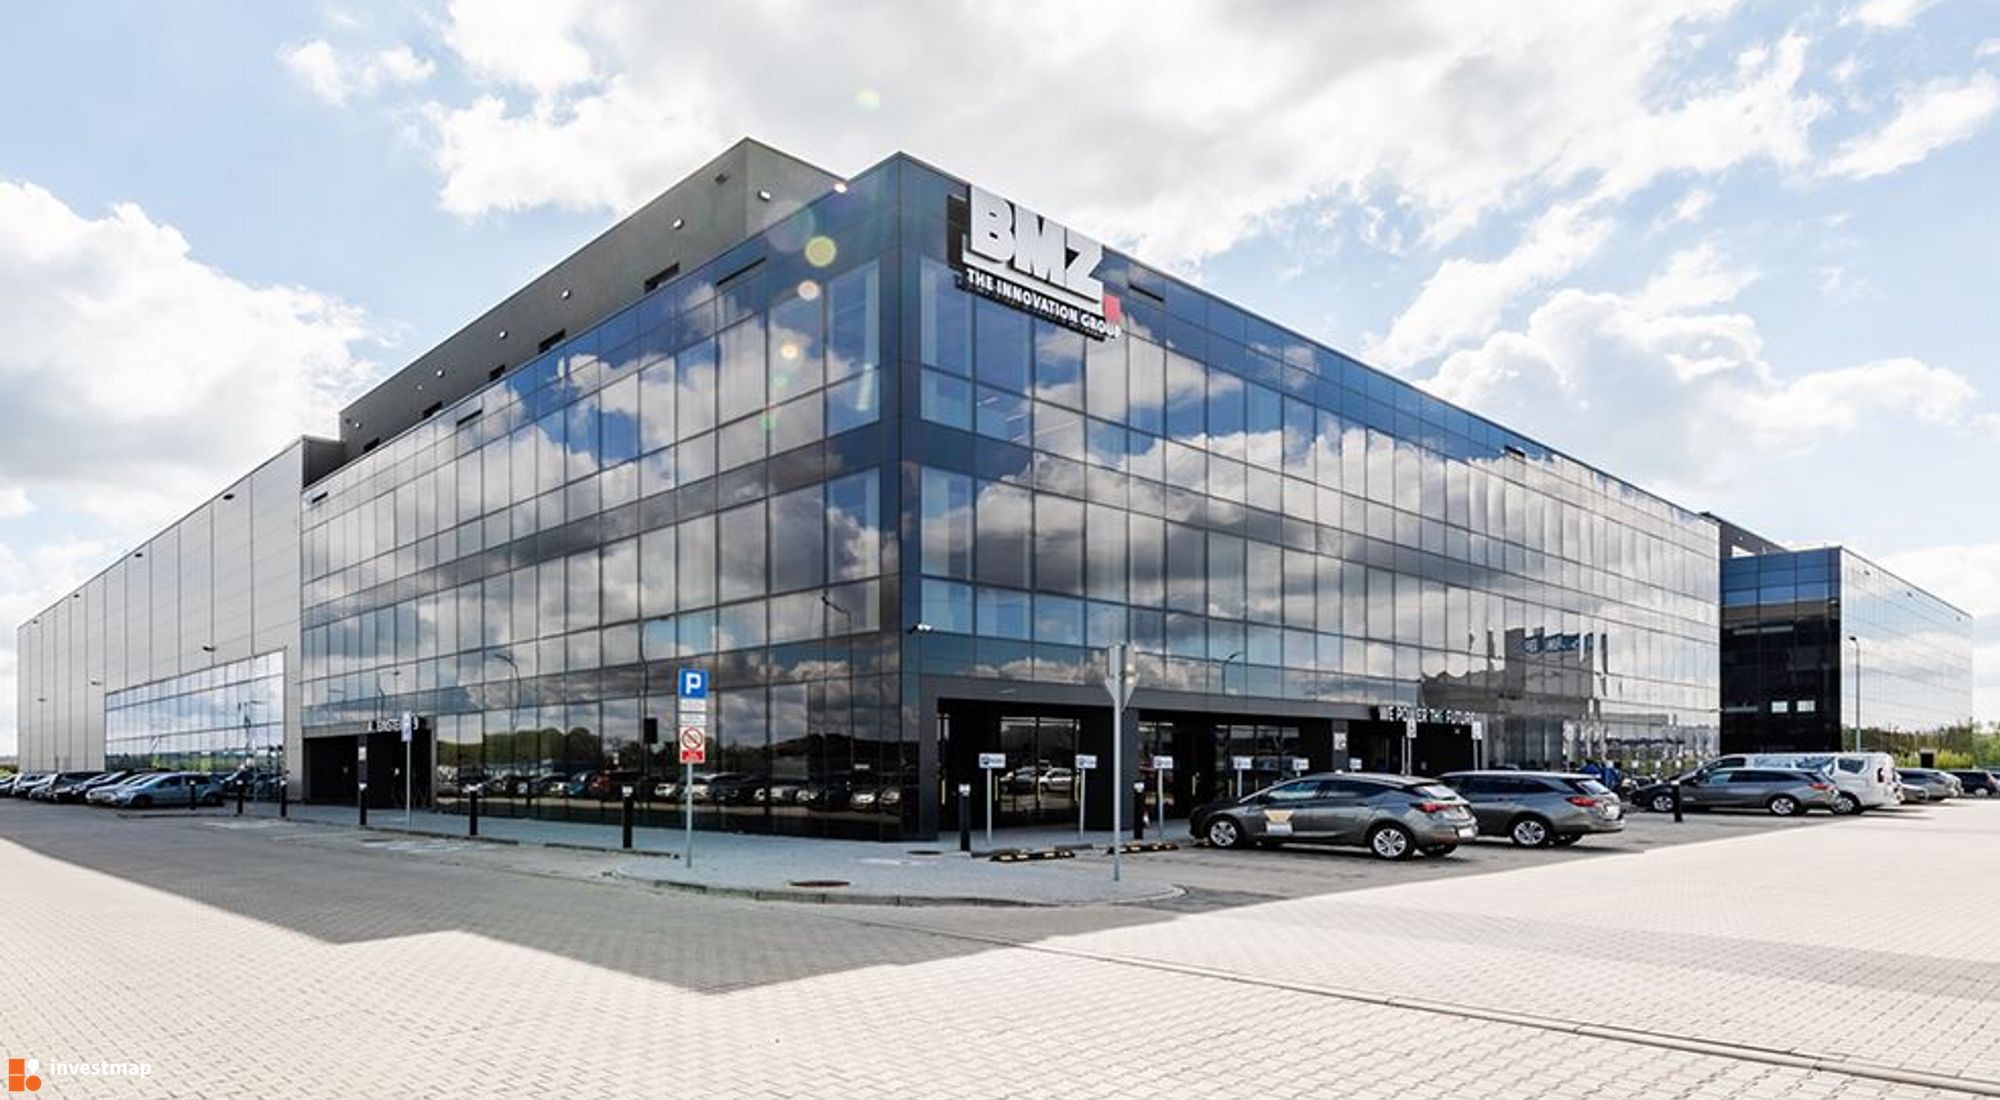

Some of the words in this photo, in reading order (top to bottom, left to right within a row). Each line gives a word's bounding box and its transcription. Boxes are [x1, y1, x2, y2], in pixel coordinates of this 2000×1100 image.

[970, 185, 1103, 302] BMZ
[965, 267, 994, 291] THE
[996, 279, 1079, 323] INNOVATION
[1080, 312, 1122, 339] GROUP
[685, 671, 702, 695] P
